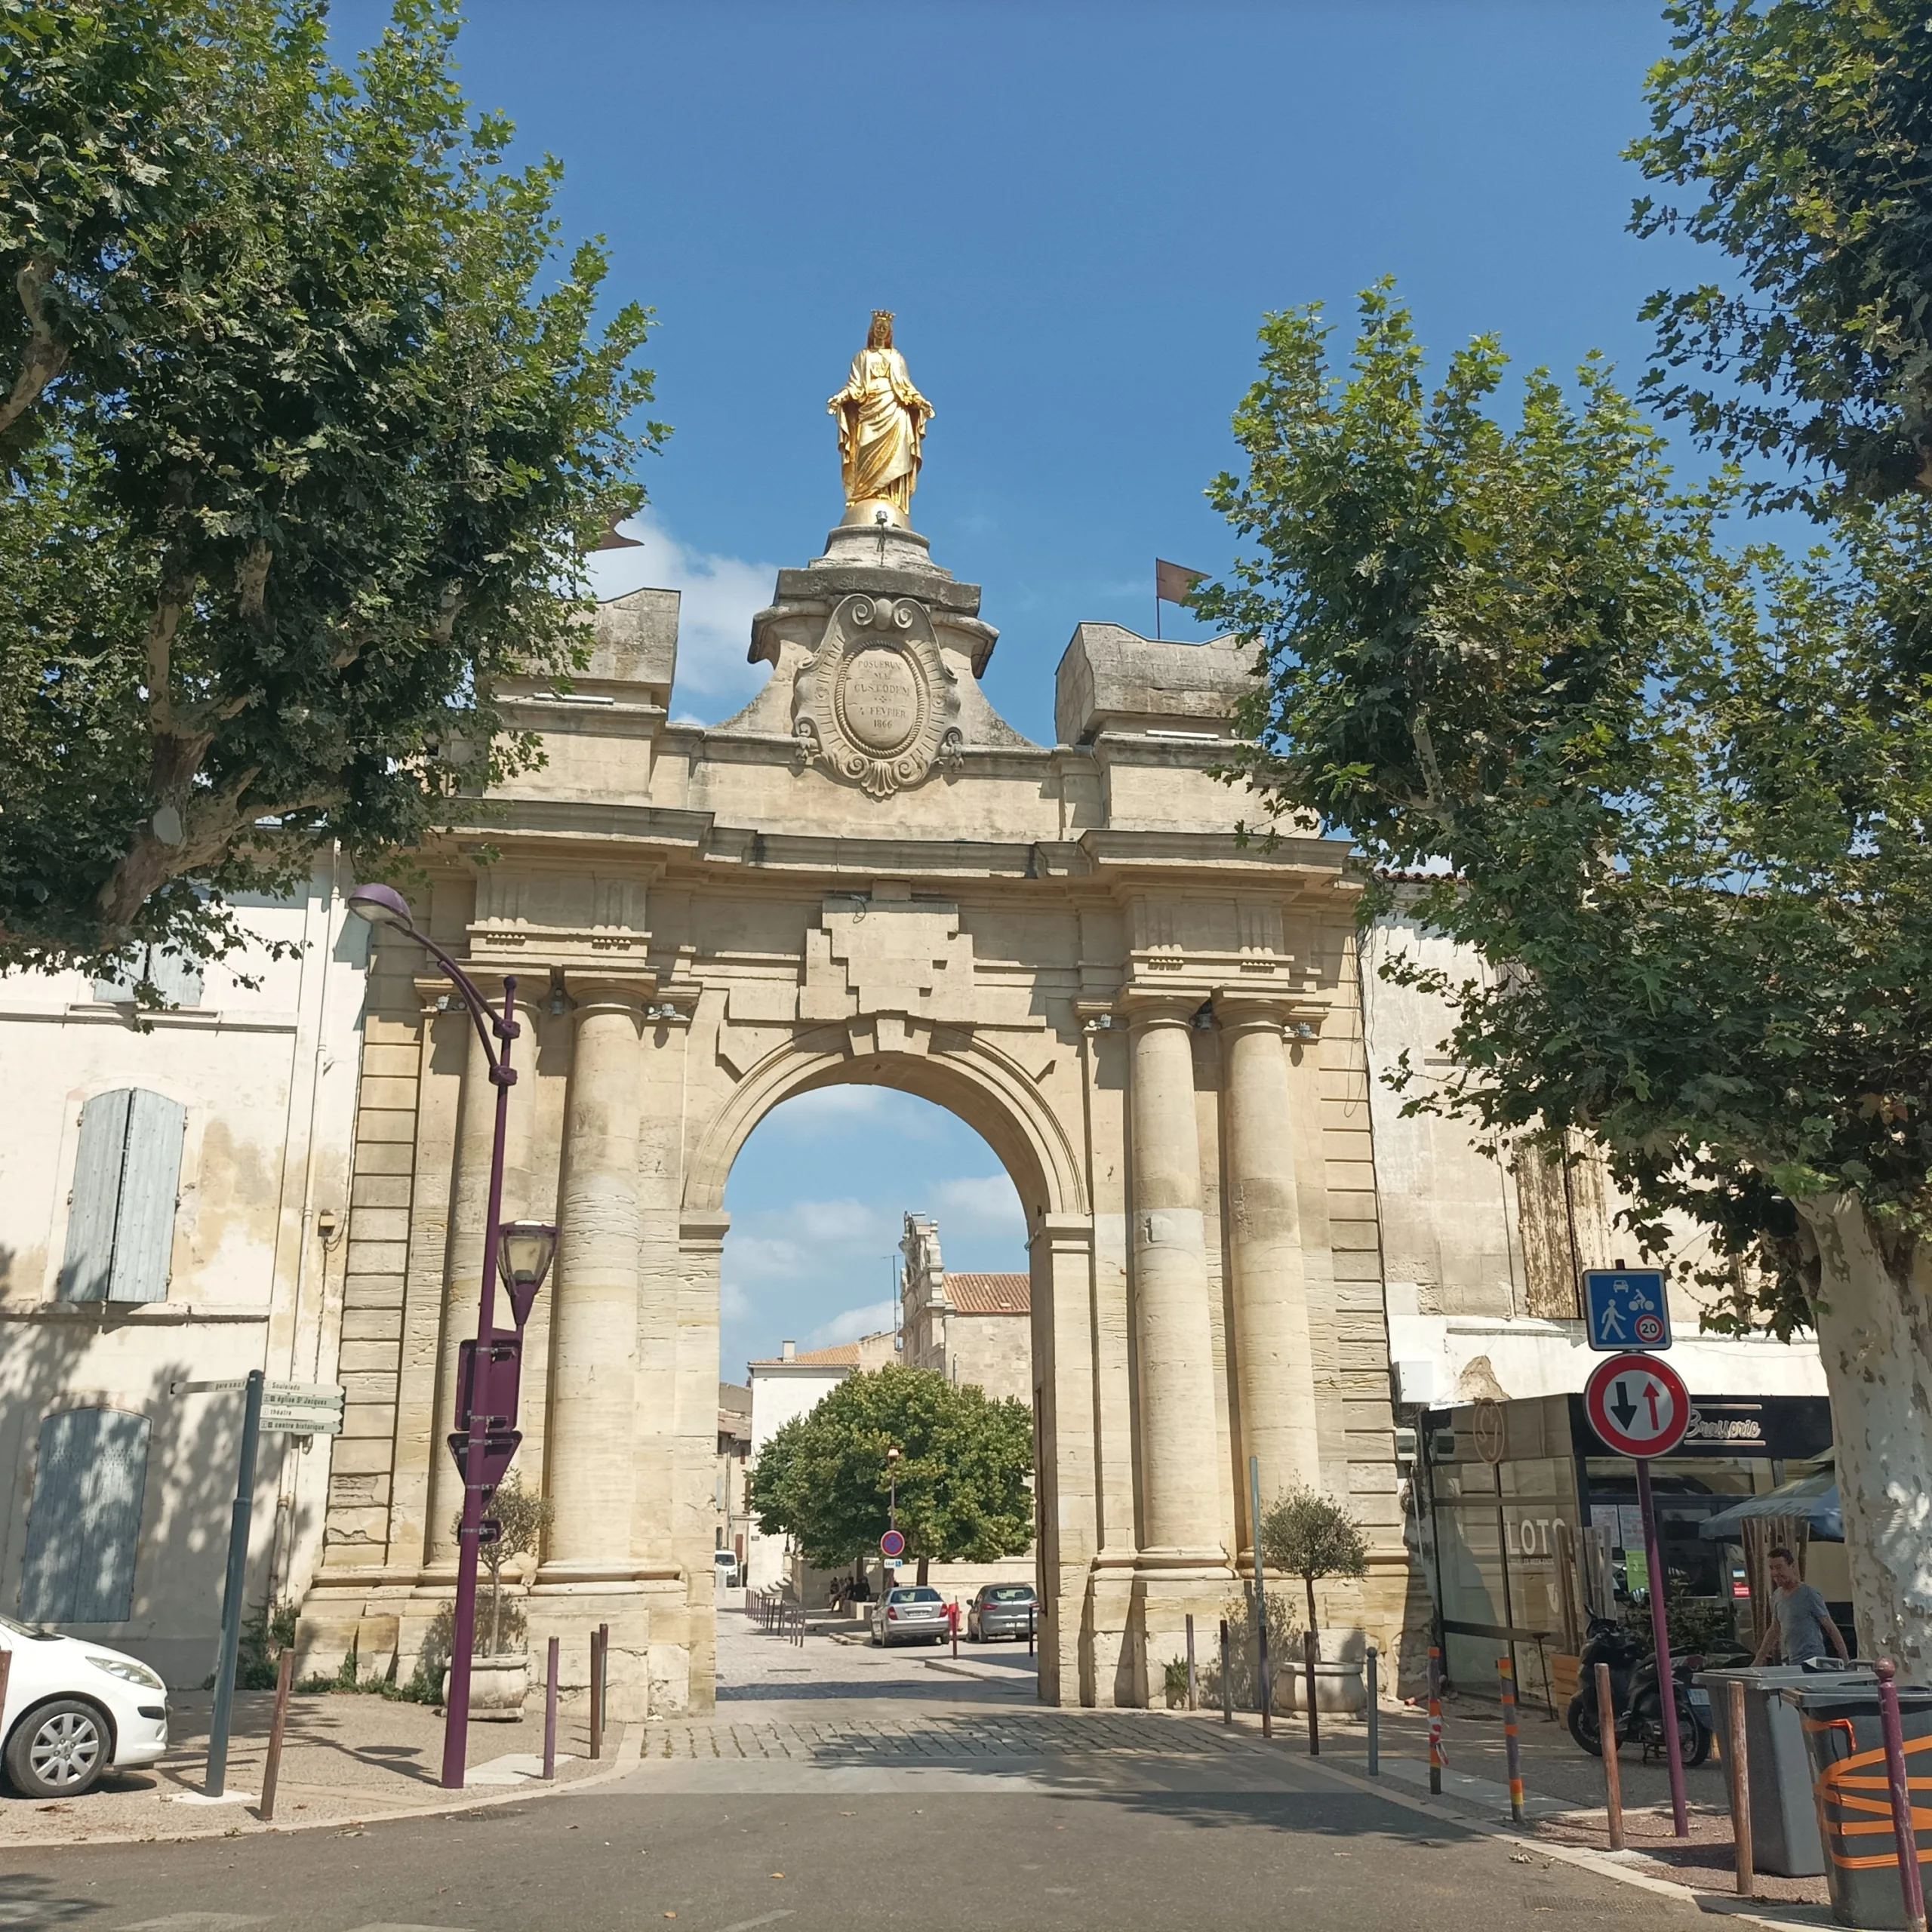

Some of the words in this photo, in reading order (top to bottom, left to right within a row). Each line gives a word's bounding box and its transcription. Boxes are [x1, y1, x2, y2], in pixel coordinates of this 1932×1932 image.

[854, 683, 910, 697] CUSTODEM
[872, 719, 893, 728] 1866
[1641, 1323, 1657, 1334] 20
[303, 1397, 328, 1406] Jacques
[295, 1423, 325, 1432] historique
[1685, 1408, 1761, 1439] Brasserie
